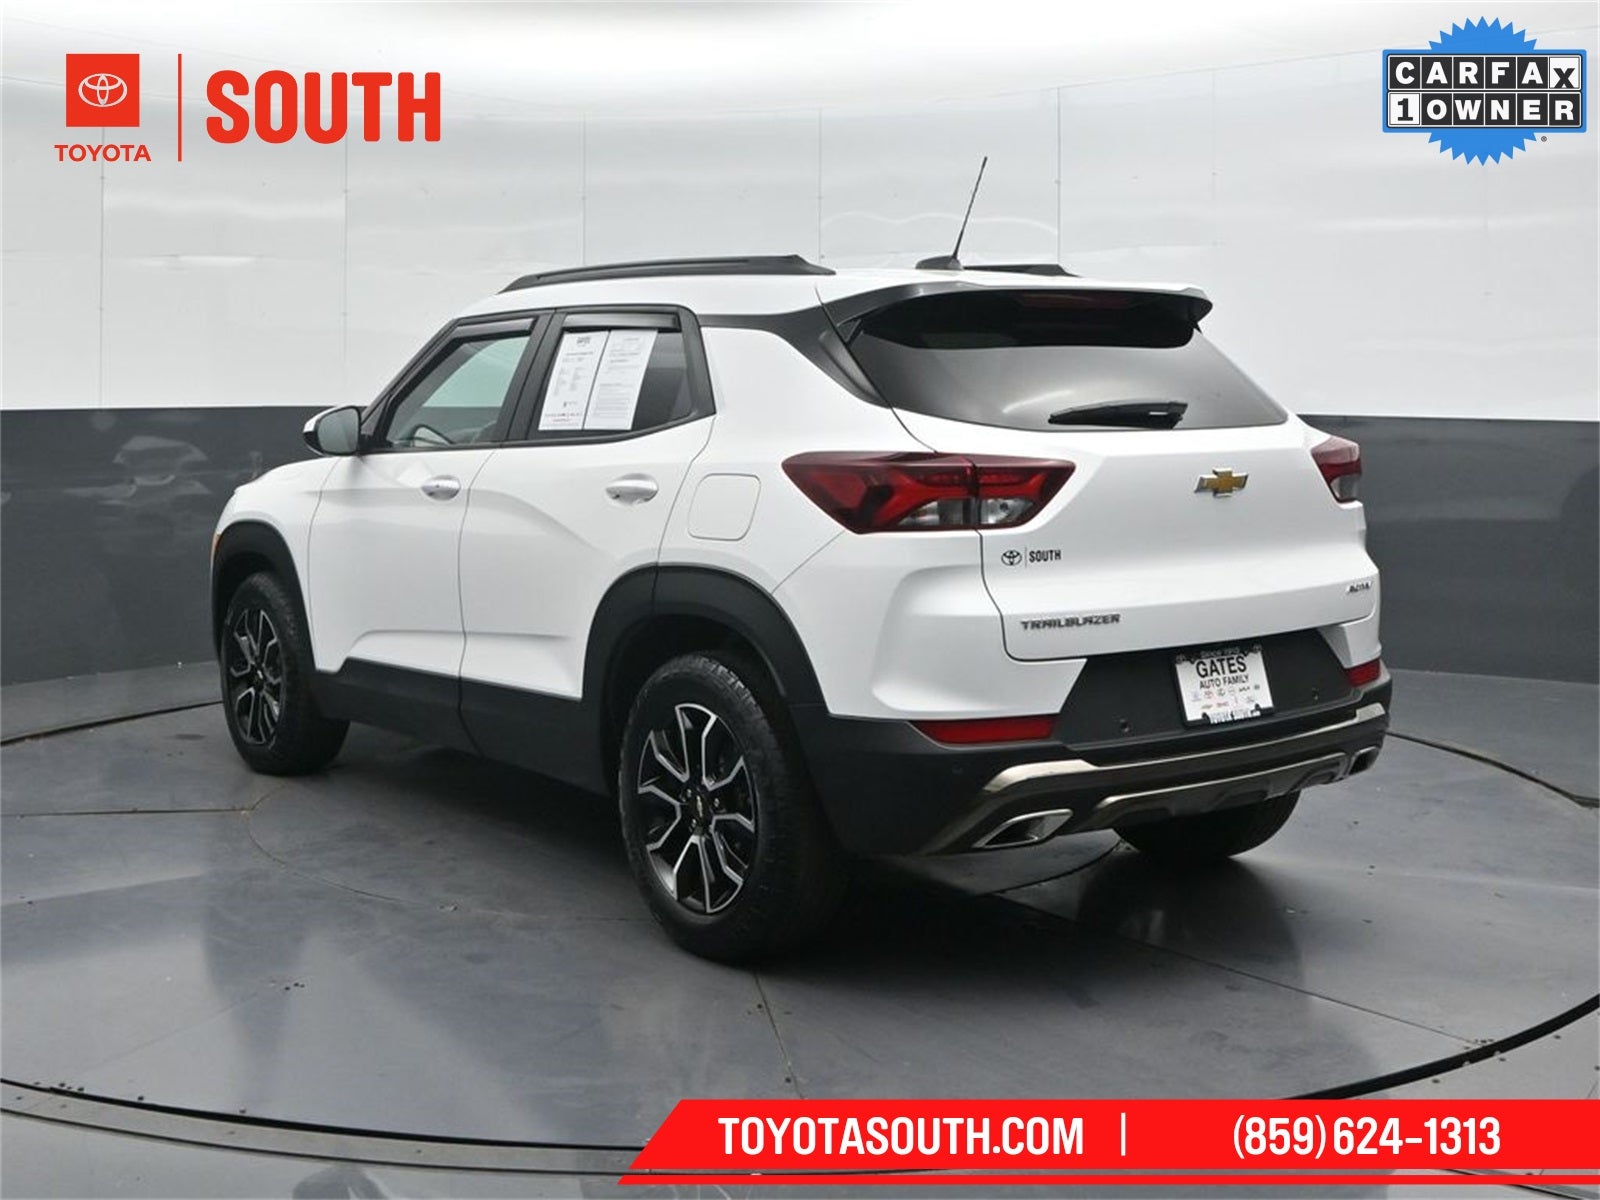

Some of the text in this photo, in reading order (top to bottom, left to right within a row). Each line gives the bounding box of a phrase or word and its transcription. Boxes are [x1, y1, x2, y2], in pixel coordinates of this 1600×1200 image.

[1029, 549, 1062, 563] SOUTH
[1020, 613, 1121, 631] TRAILBLAZER
[1196, 655, 1247, 679] GATES
[1200, 674, 1250, 690] AUTO FAMILY
